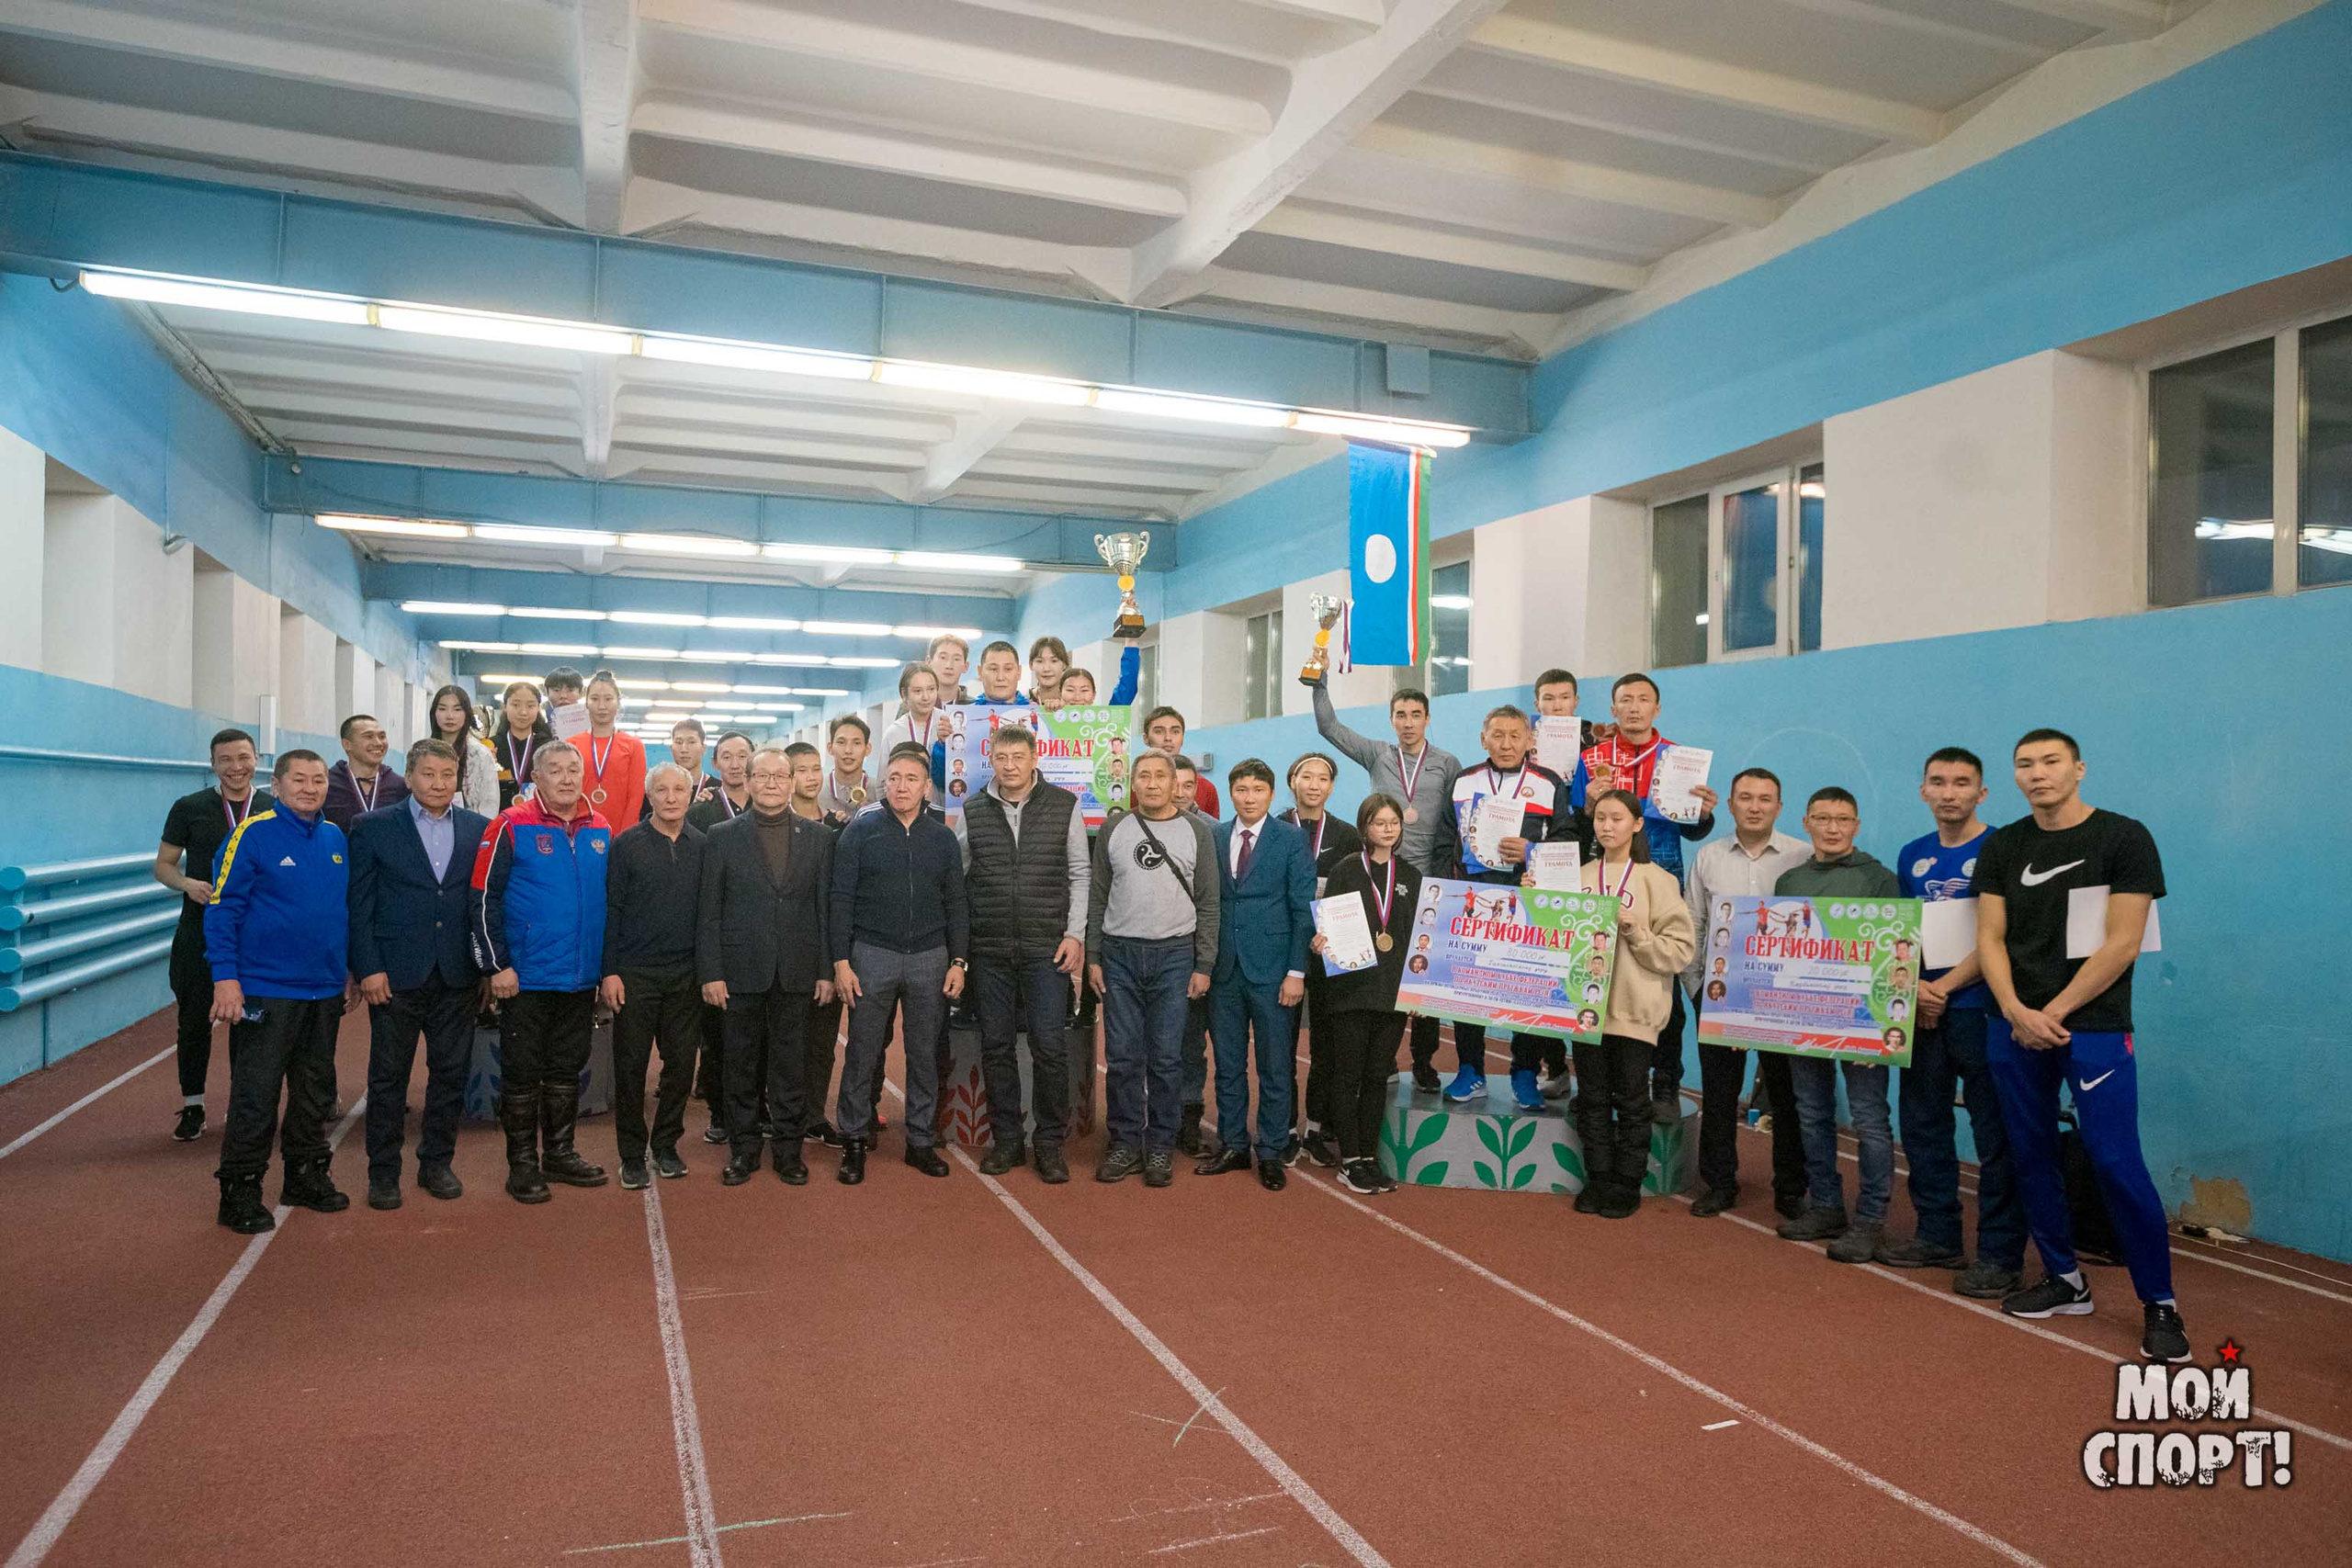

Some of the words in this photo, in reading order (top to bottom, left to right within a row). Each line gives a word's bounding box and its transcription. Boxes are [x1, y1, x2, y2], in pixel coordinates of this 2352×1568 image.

[980, 739, 1094, 758] СФИКАТ
[1450, 917, 1575, 950] СЕРТИФИКАТ
[1448, 940, 1459, 950] НА
[1461, 942, 1487, 953] СУММУ
[1746, 935, 1875, 963] СЕРТИФИКАТ
[1744, 961, 1755, 970] НА
[1758, 962, 1784, 973] СУММУ
[1518, 975, 1558, 987] ФЕДЕРАЦИИ
